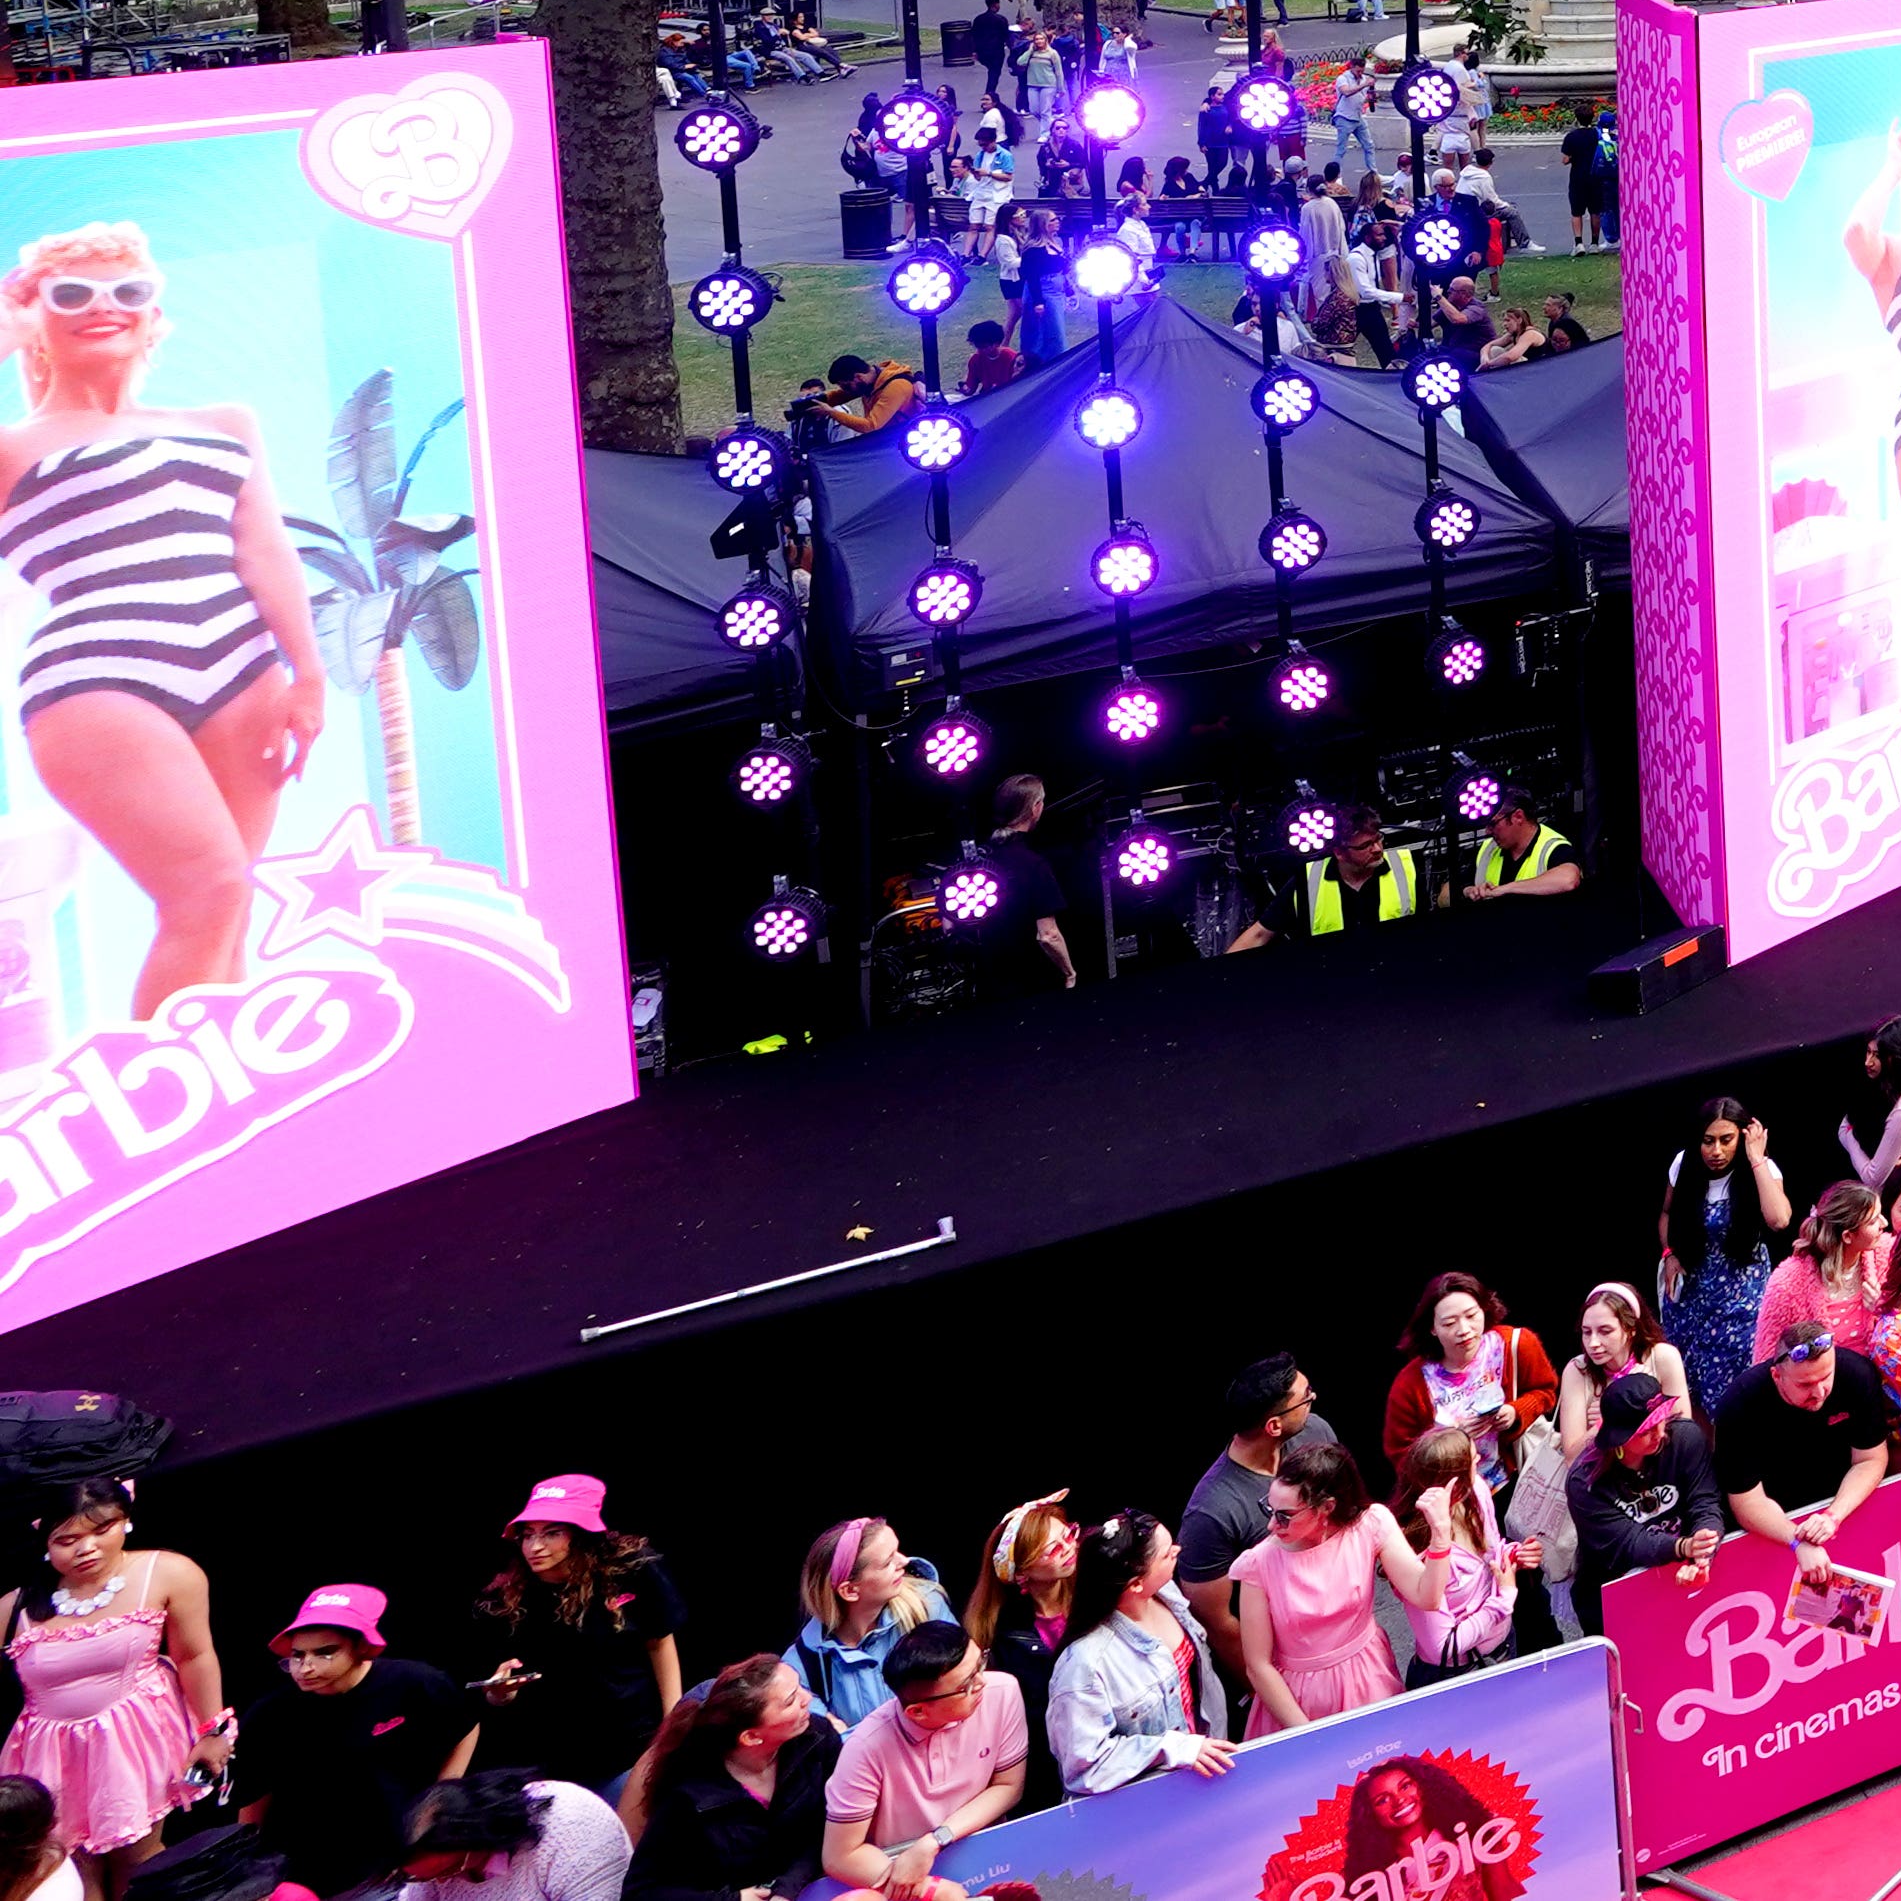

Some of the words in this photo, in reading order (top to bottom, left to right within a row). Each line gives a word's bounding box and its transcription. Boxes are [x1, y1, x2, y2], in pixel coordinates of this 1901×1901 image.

[1346, 1751, 1374, 1769] Issa
[1375, 1740, 1403, 1756] Rae
[1701, 1744, 1749, 1778] In
[1754, 1683, 1901, 1761] cinemas
